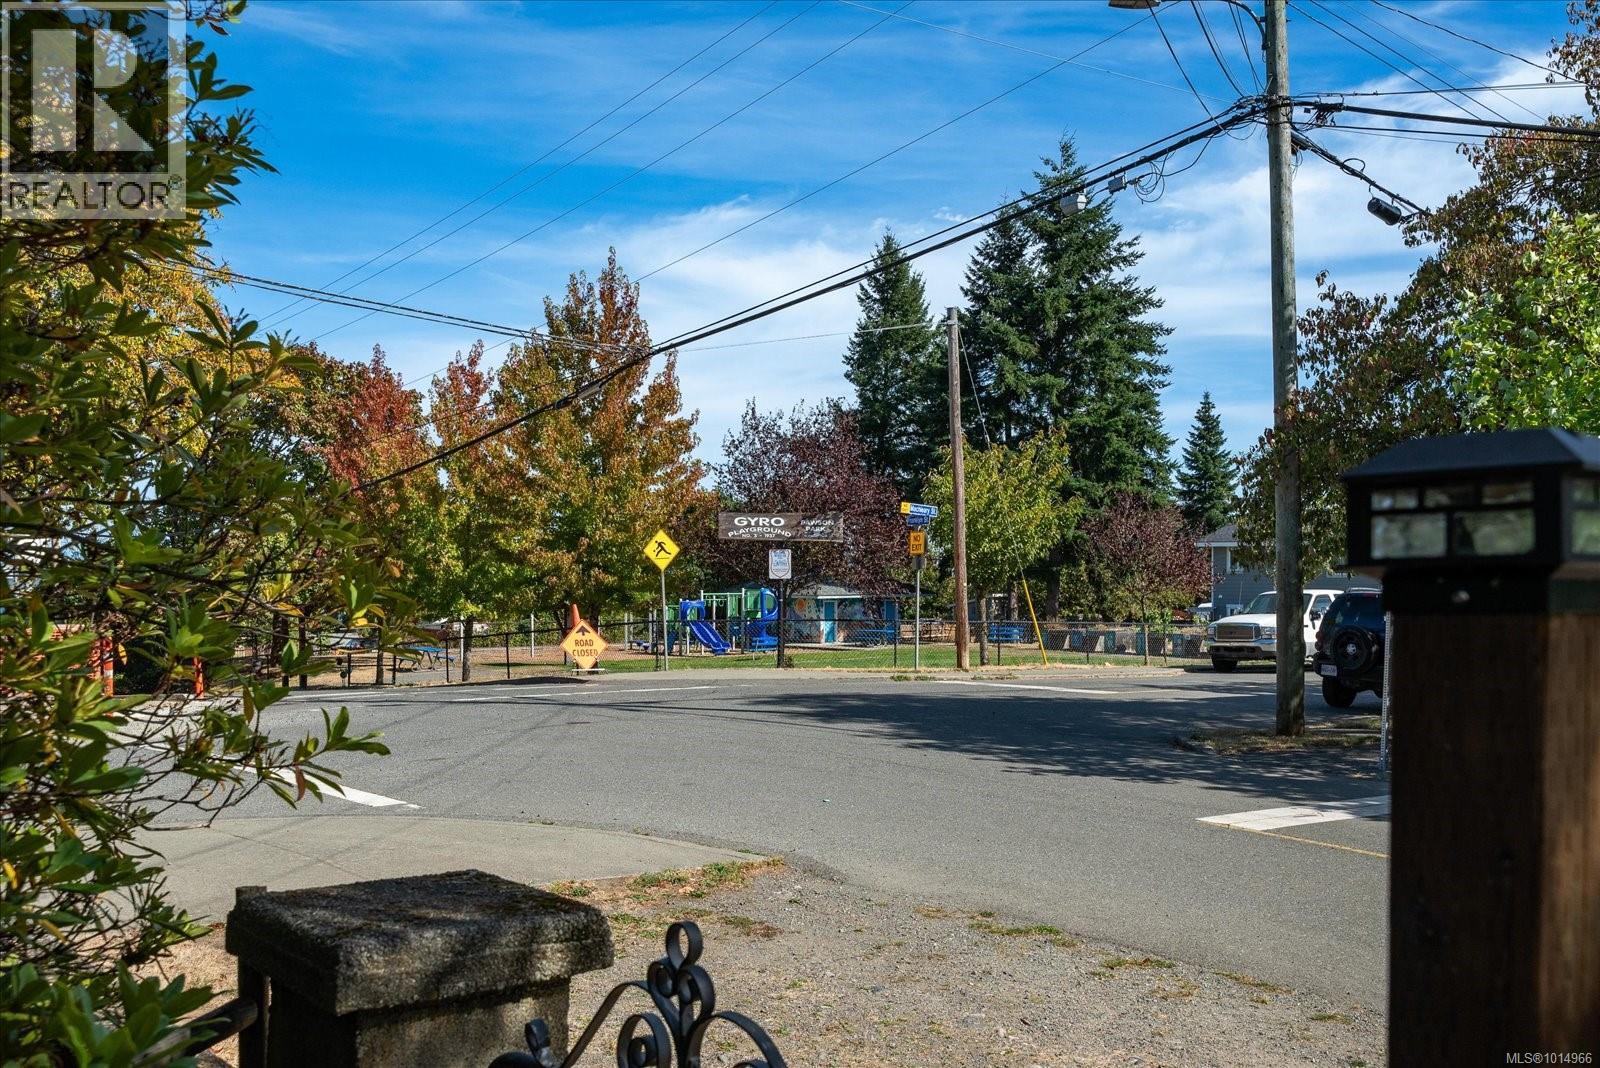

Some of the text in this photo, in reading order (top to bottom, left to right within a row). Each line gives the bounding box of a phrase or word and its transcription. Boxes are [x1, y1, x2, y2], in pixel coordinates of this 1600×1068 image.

[734, 517, 784, 526] GYRO
[728, 527, 791, 538] PLAYGROUND
[575, 639, 594, 647] ROAD
[572, 649, 598, 657] CLOSED
